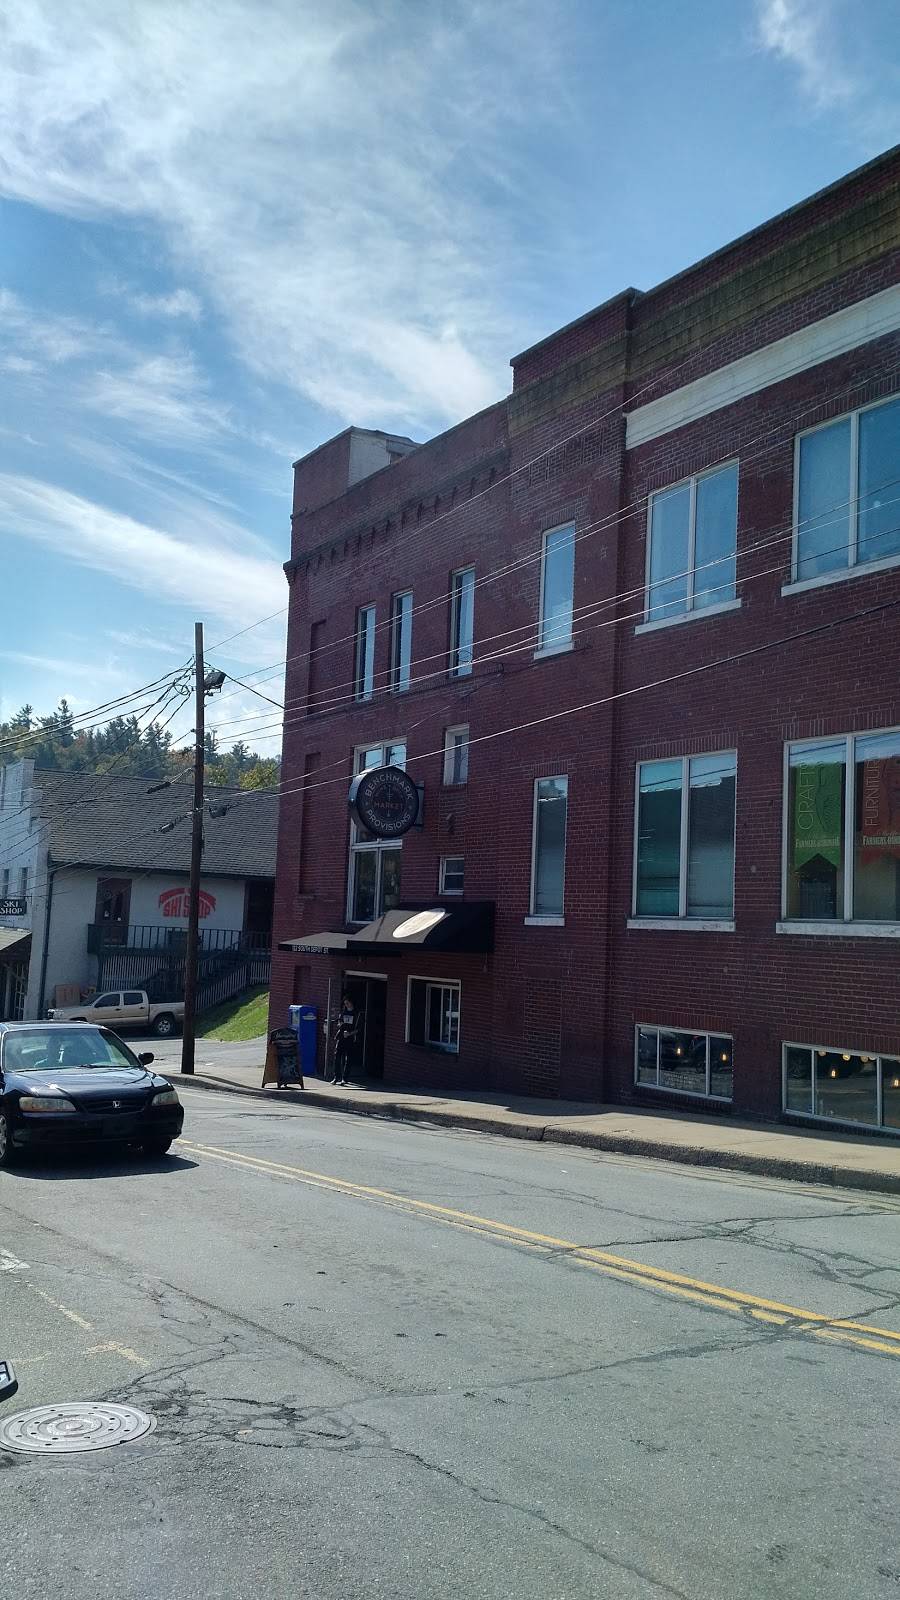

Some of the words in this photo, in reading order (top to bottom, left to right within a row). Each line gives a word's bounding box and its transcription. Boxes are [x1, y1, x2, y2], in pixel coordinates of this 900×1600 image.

[365, 773, 414, 800] BENCHMARK
[375, 802, 402, 810] MARKET
[367, 809, 411, 831] PROVISIONS
[163, 895, 181, 917] SKI
[183, 895, 210, 918] SOP
